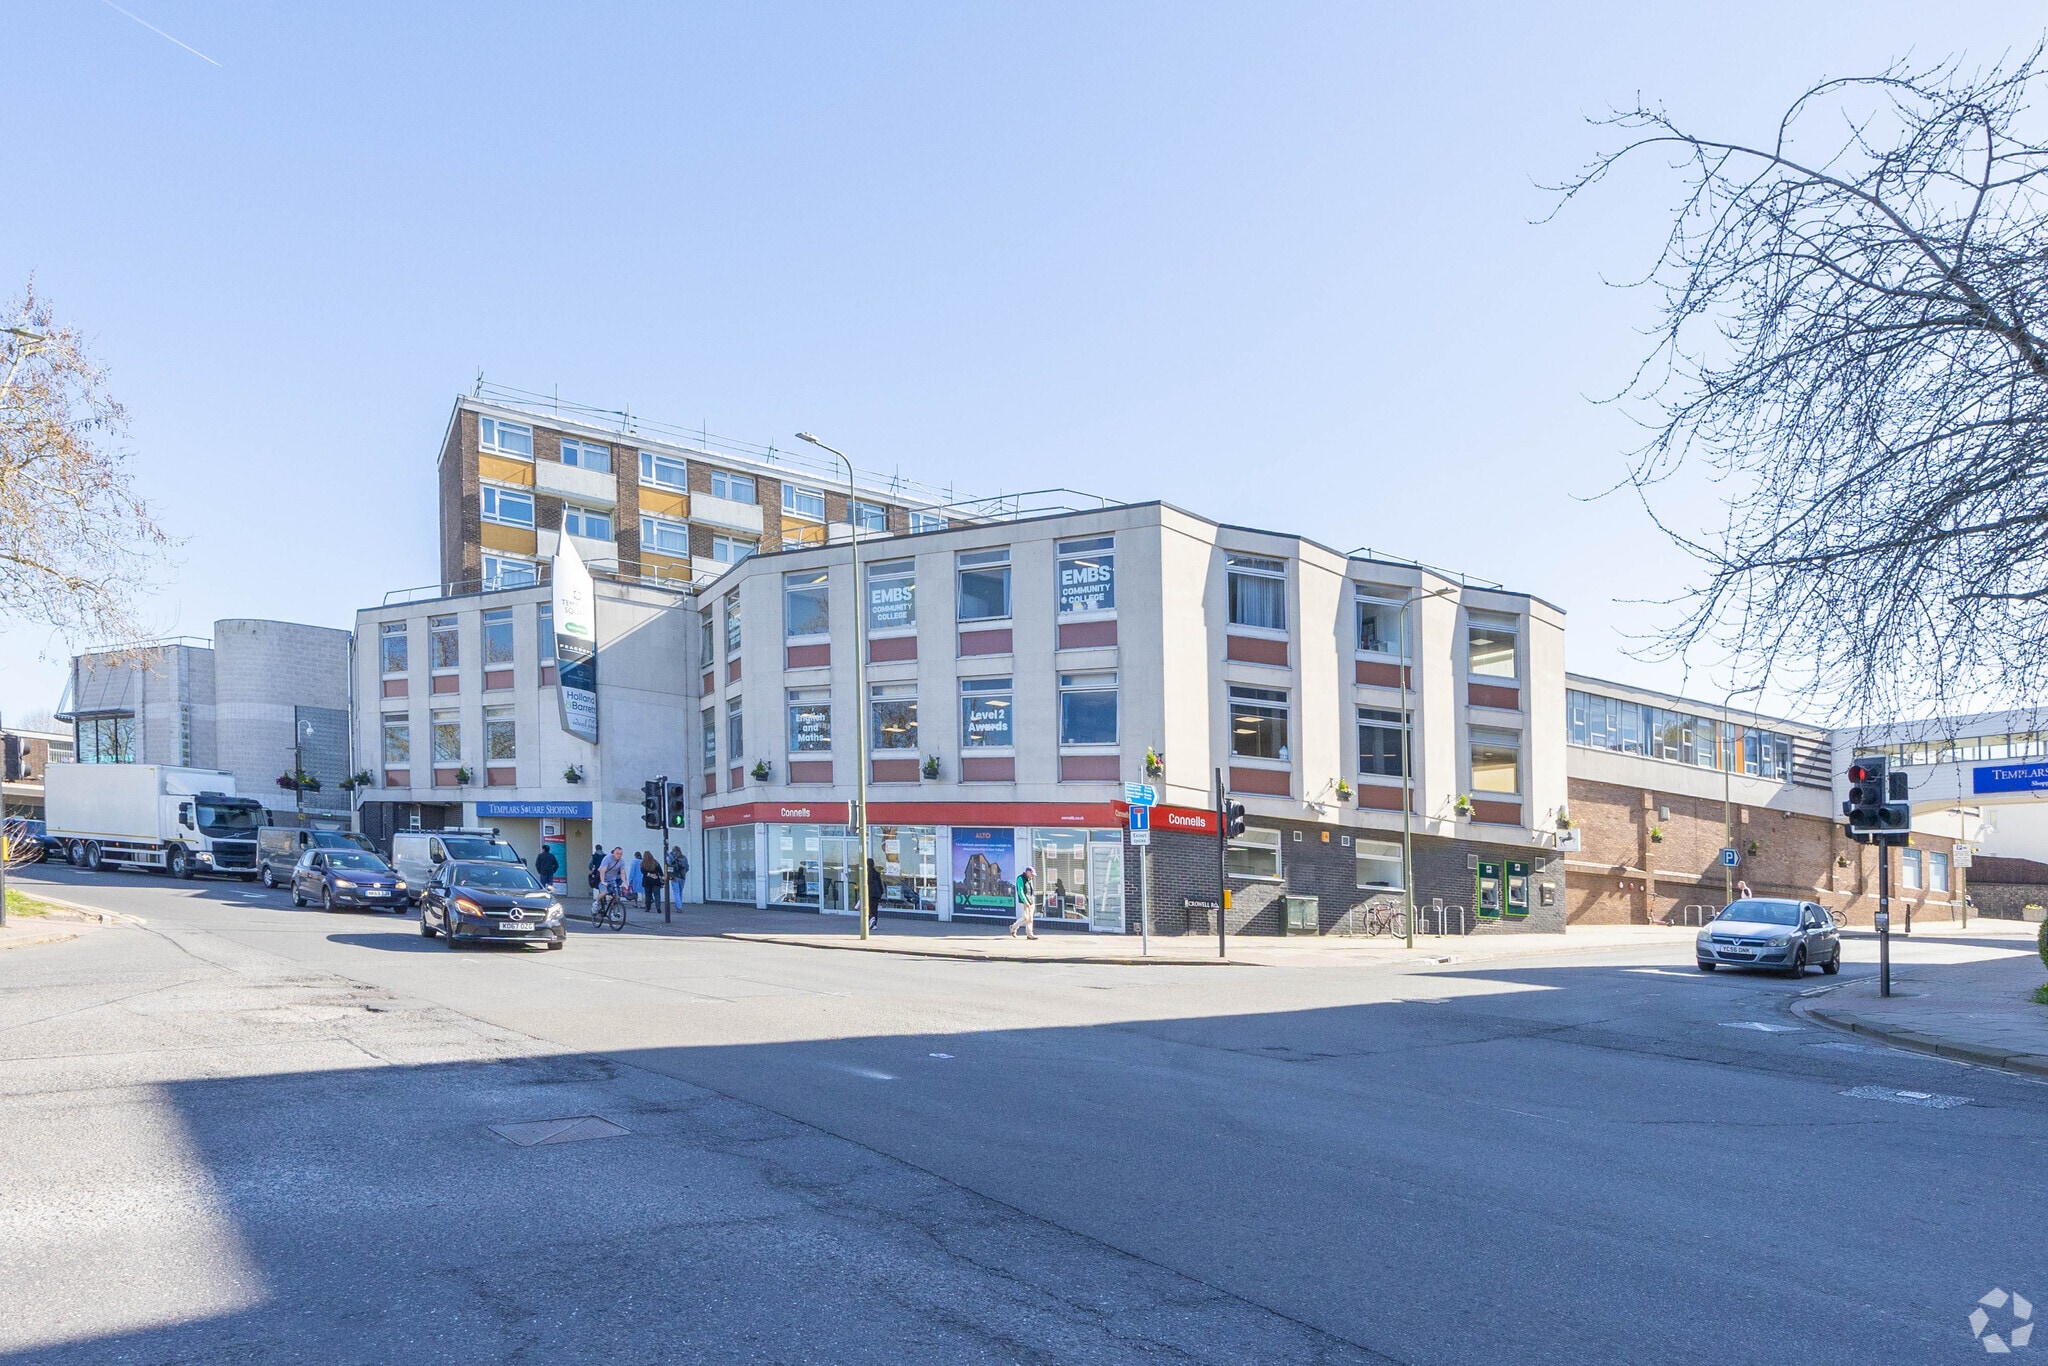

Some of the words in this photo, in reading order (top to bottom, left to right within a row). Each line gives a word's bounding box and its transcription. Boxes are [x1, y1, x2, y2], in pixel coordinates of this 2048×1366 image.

[1062, 565, 1111, 585] EMBS
[1063, 583, 1111, 595] COMMUNITY
[872, 586, 912, 604] EMBS
[1069, 593, 1105, 603] COLLEGE
[872, 603, 912, 613] COMMUNITY
[877, 611, 908, 620] COLLEGE
[567, 691, 595, 704] Holland
[796, 712, 825, 724] English
[971, 710, 998, 720] Level
[998, 709, 1005, 719] 2
[802, 723, 818, 732] and
[968, 721, 1008, 731] Awards
[798, 733, 824, 742] Maths
[1991, 768, 2048, 780] TEMPLARS
[489, 804, 520, 813] TEMPLARS
[546, 805, 578, 815] SHOPPING
[781, 807, 811, 818] Connells
[1169, 813, 1206, 827] Connells
